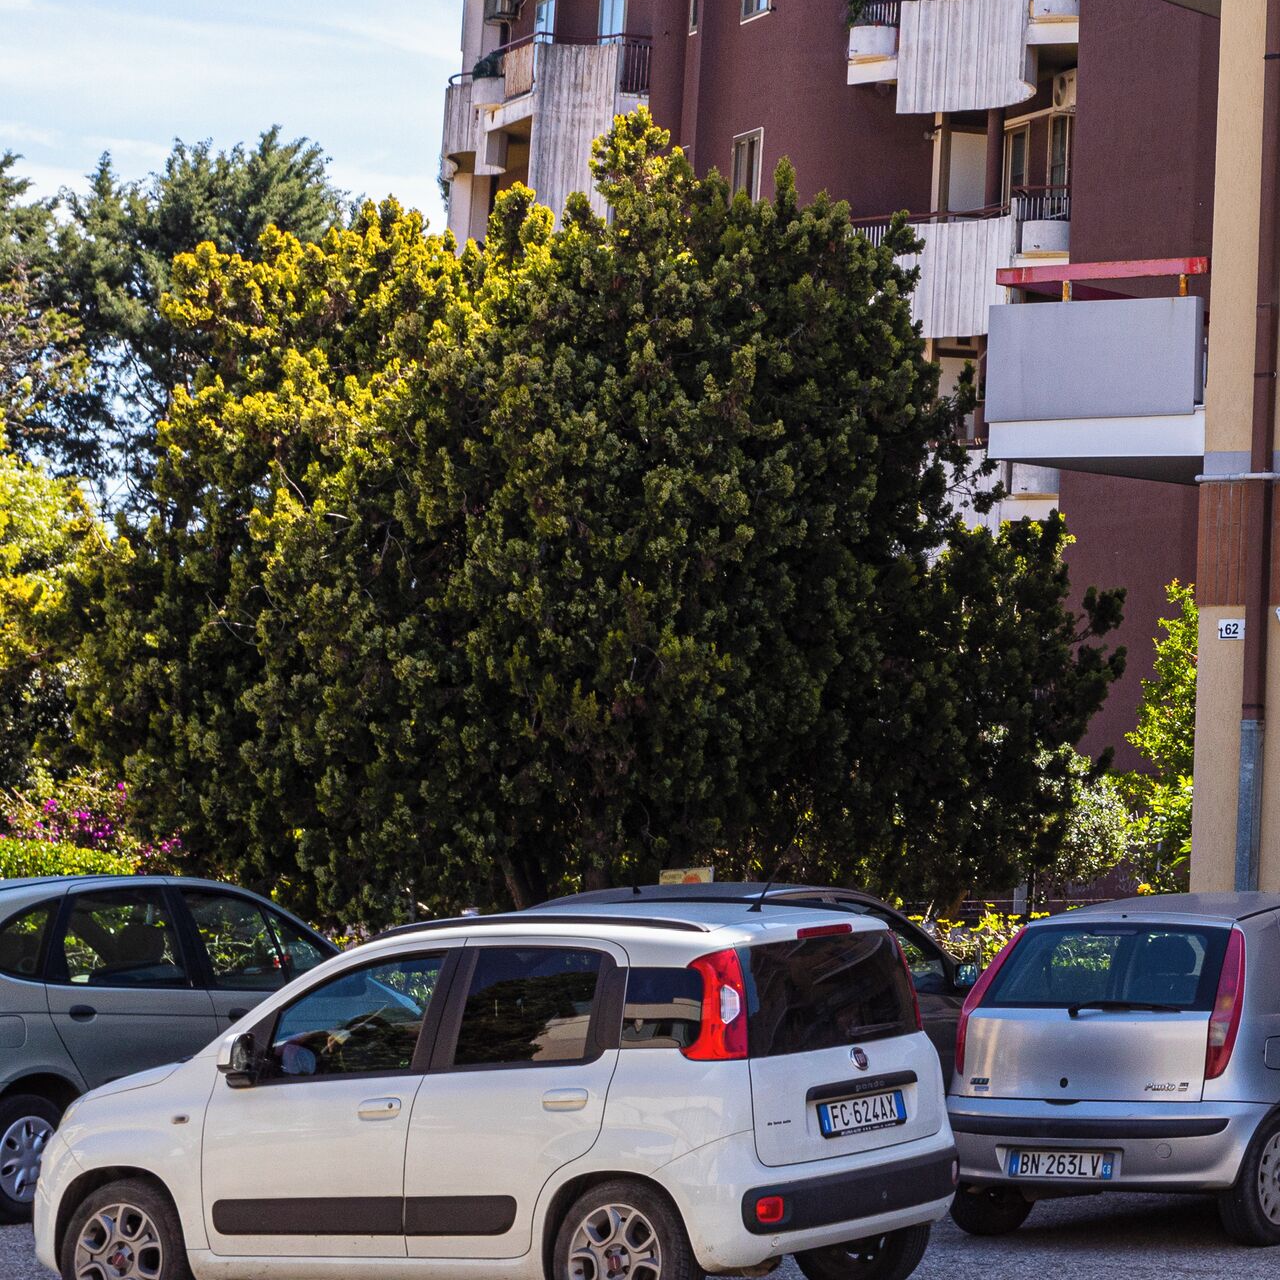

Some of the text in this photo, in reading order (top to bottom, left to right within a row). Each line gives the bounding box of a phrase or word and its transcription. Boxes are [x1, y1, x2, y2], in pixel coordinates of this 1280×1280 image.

[1224, 623, 1239, 635] 62
[1144, 1082, 1176, 1091] Punto
[830, 1104, 850, 1129] FC
[852, 1094, 896, 1124] 624AX
[1020, 1154, 1040, 1174] BN
[1045, 1154, 1100, 1176] 263LV
